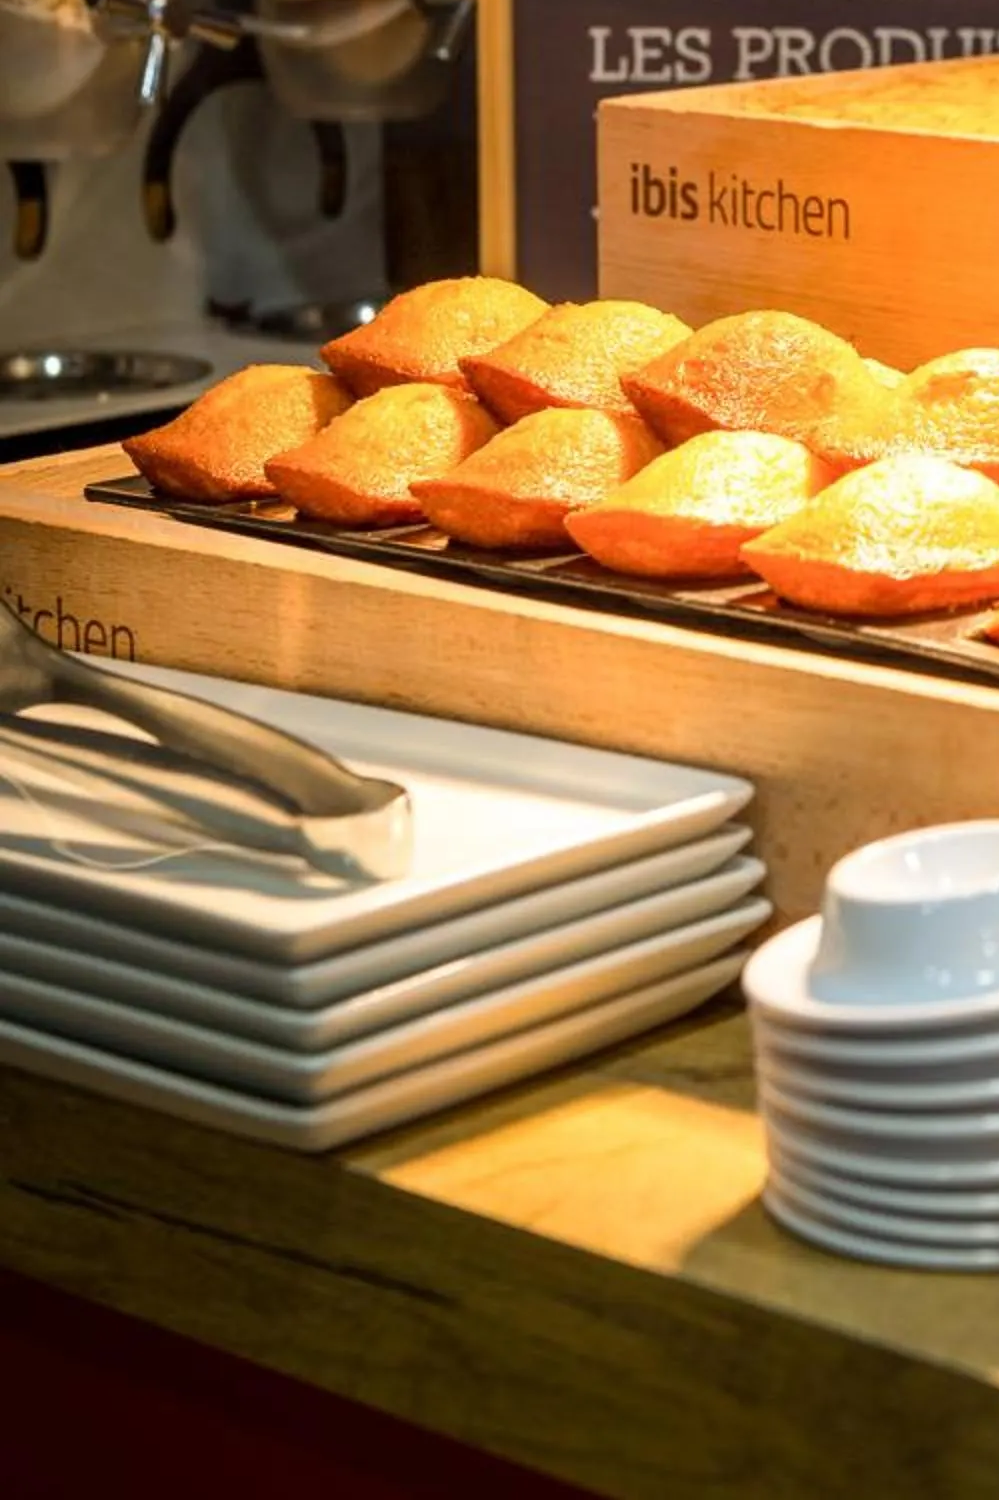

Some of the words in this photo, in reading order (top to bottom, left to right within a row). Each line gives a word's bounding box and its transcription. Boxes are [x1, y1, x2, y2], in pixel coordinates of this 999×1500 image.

[588, 25, 713, 83] LES
[630, 162, 699, 221] ibis
[708, 169, 851, 241] kitchen
[5, 586, 135, 663] chen
